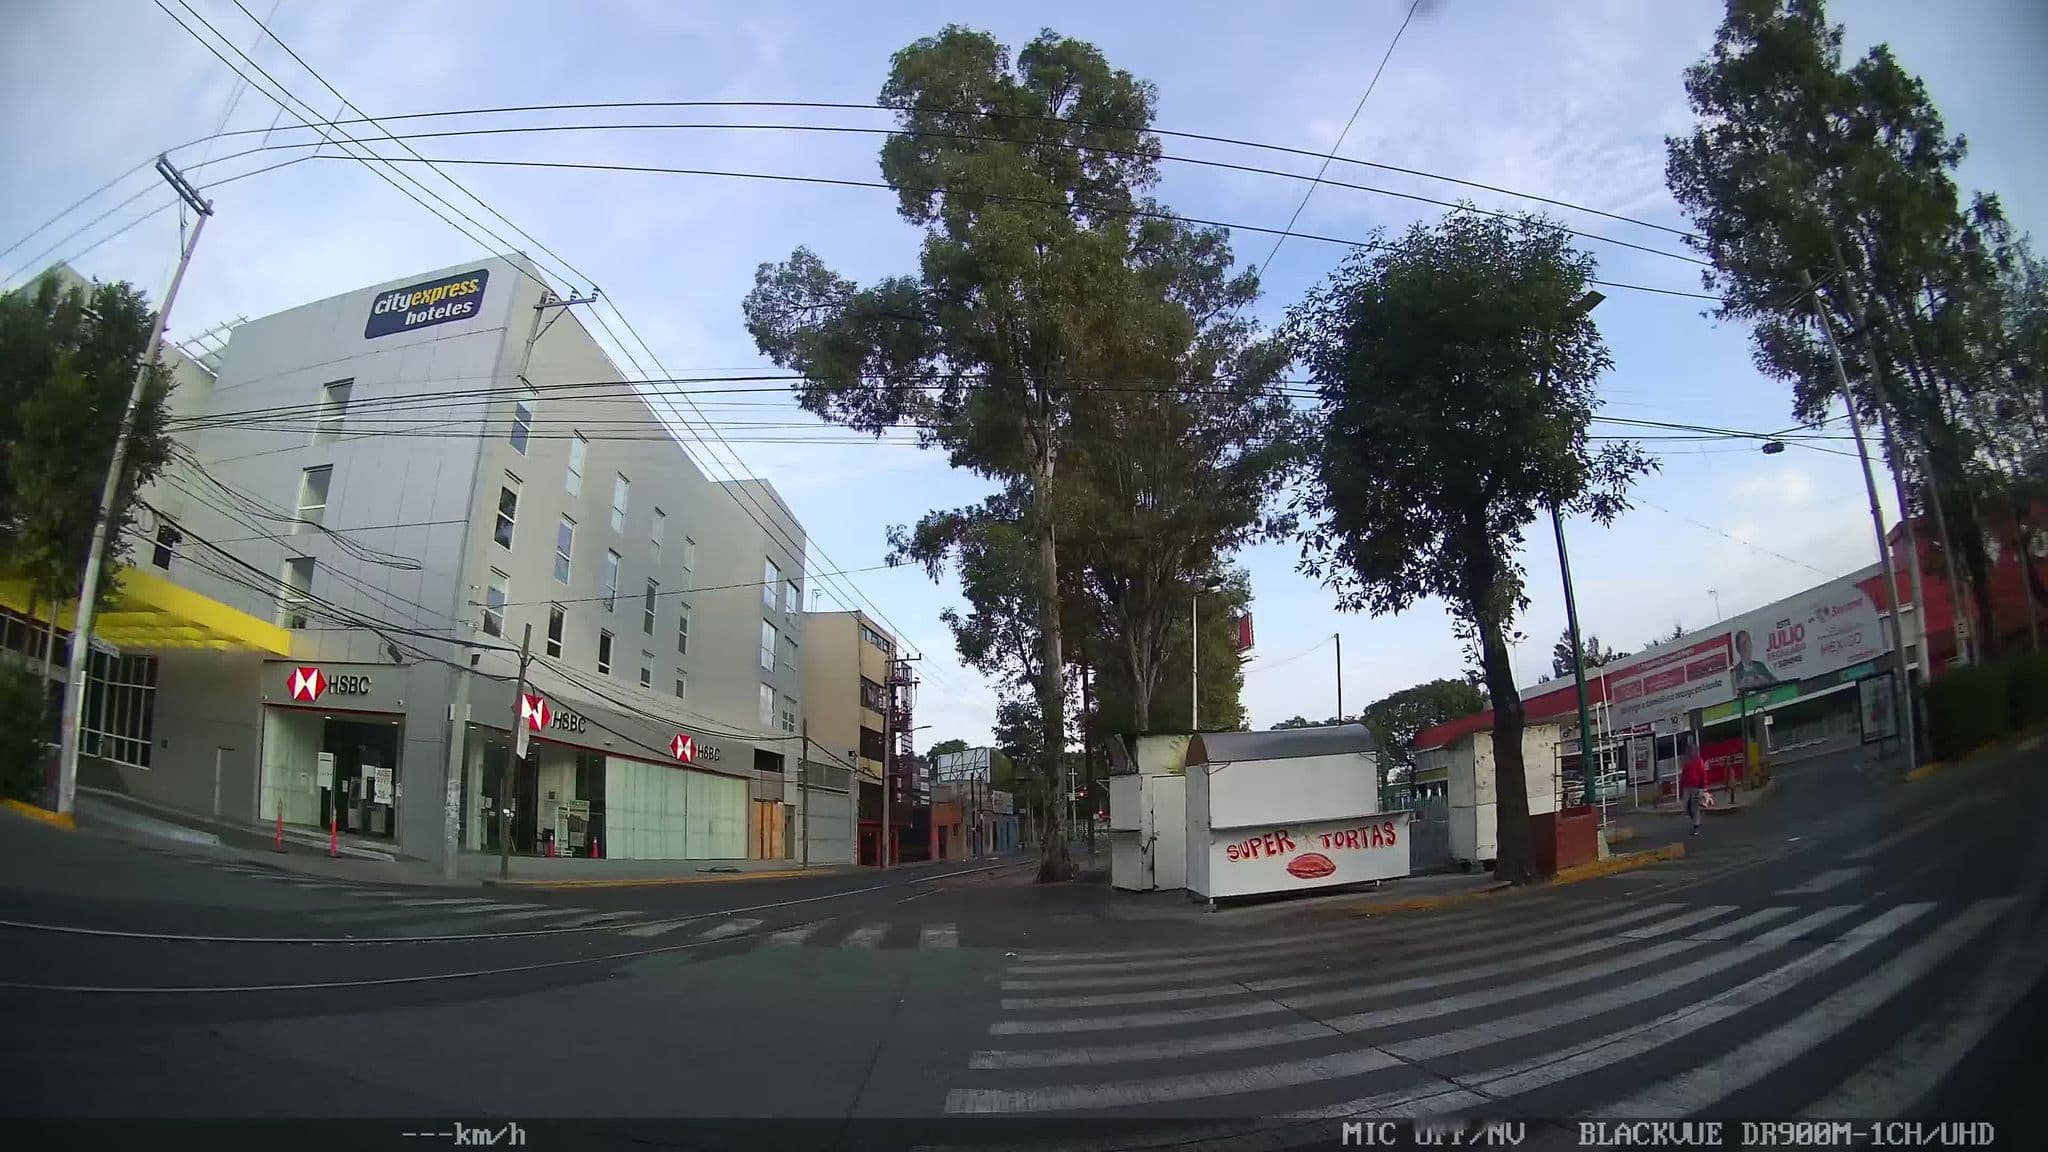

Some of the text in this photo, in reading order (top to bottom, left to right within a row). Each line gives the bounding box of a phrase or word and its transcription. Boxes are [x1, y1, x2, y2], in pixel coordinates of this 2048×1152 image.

[405, 301, 474, 326] hoteles
[1766, 623, 1805, 652] JULIO
[328, 674, 372, 695] HSBC
[551, 709, 588, 734] HSBC
[697, 744, 720, 761] HSBC
[1227, 821, 1397, 862] SUPER TORTAS
